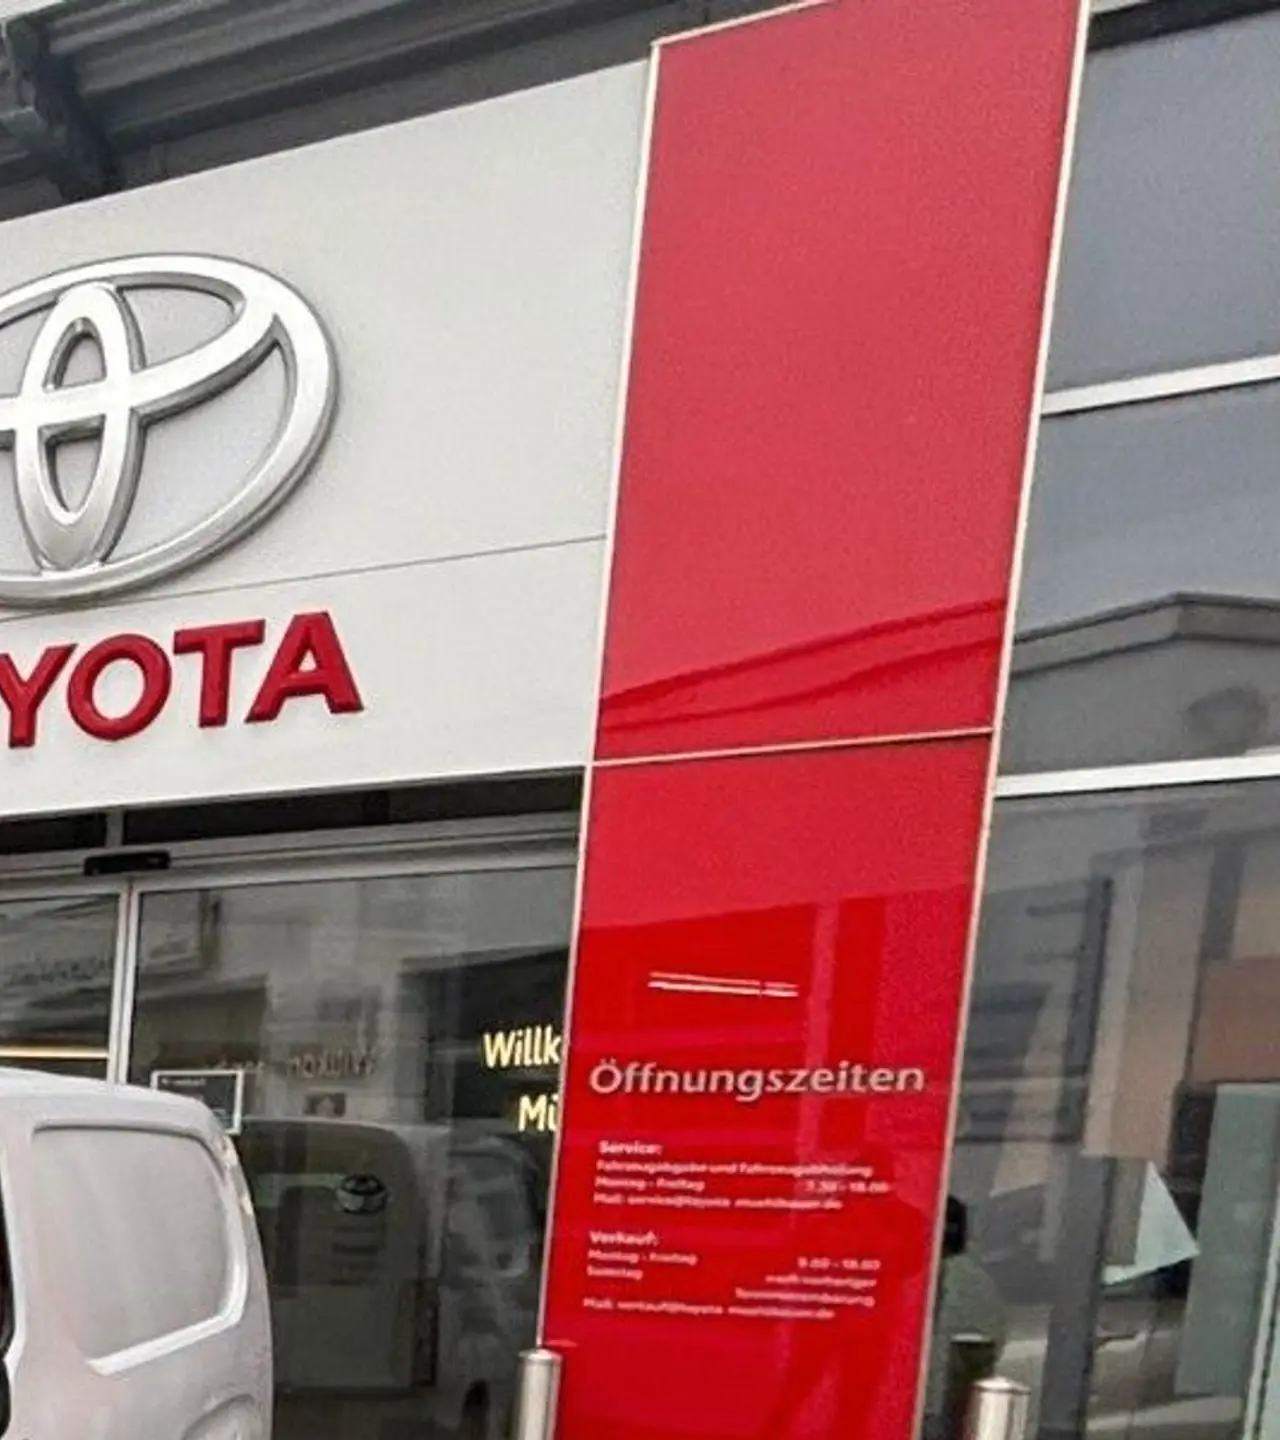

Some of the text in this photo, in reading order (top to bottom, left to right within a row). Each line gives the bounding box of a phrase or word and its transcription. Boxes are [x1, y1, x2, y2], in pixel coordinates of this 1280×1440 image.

[589, 1057, 925, 1101] Öffnungszeiten
[597, 1140, 664, 1156] Service:
[590, 1230, 660, 1247] Verkauf:
